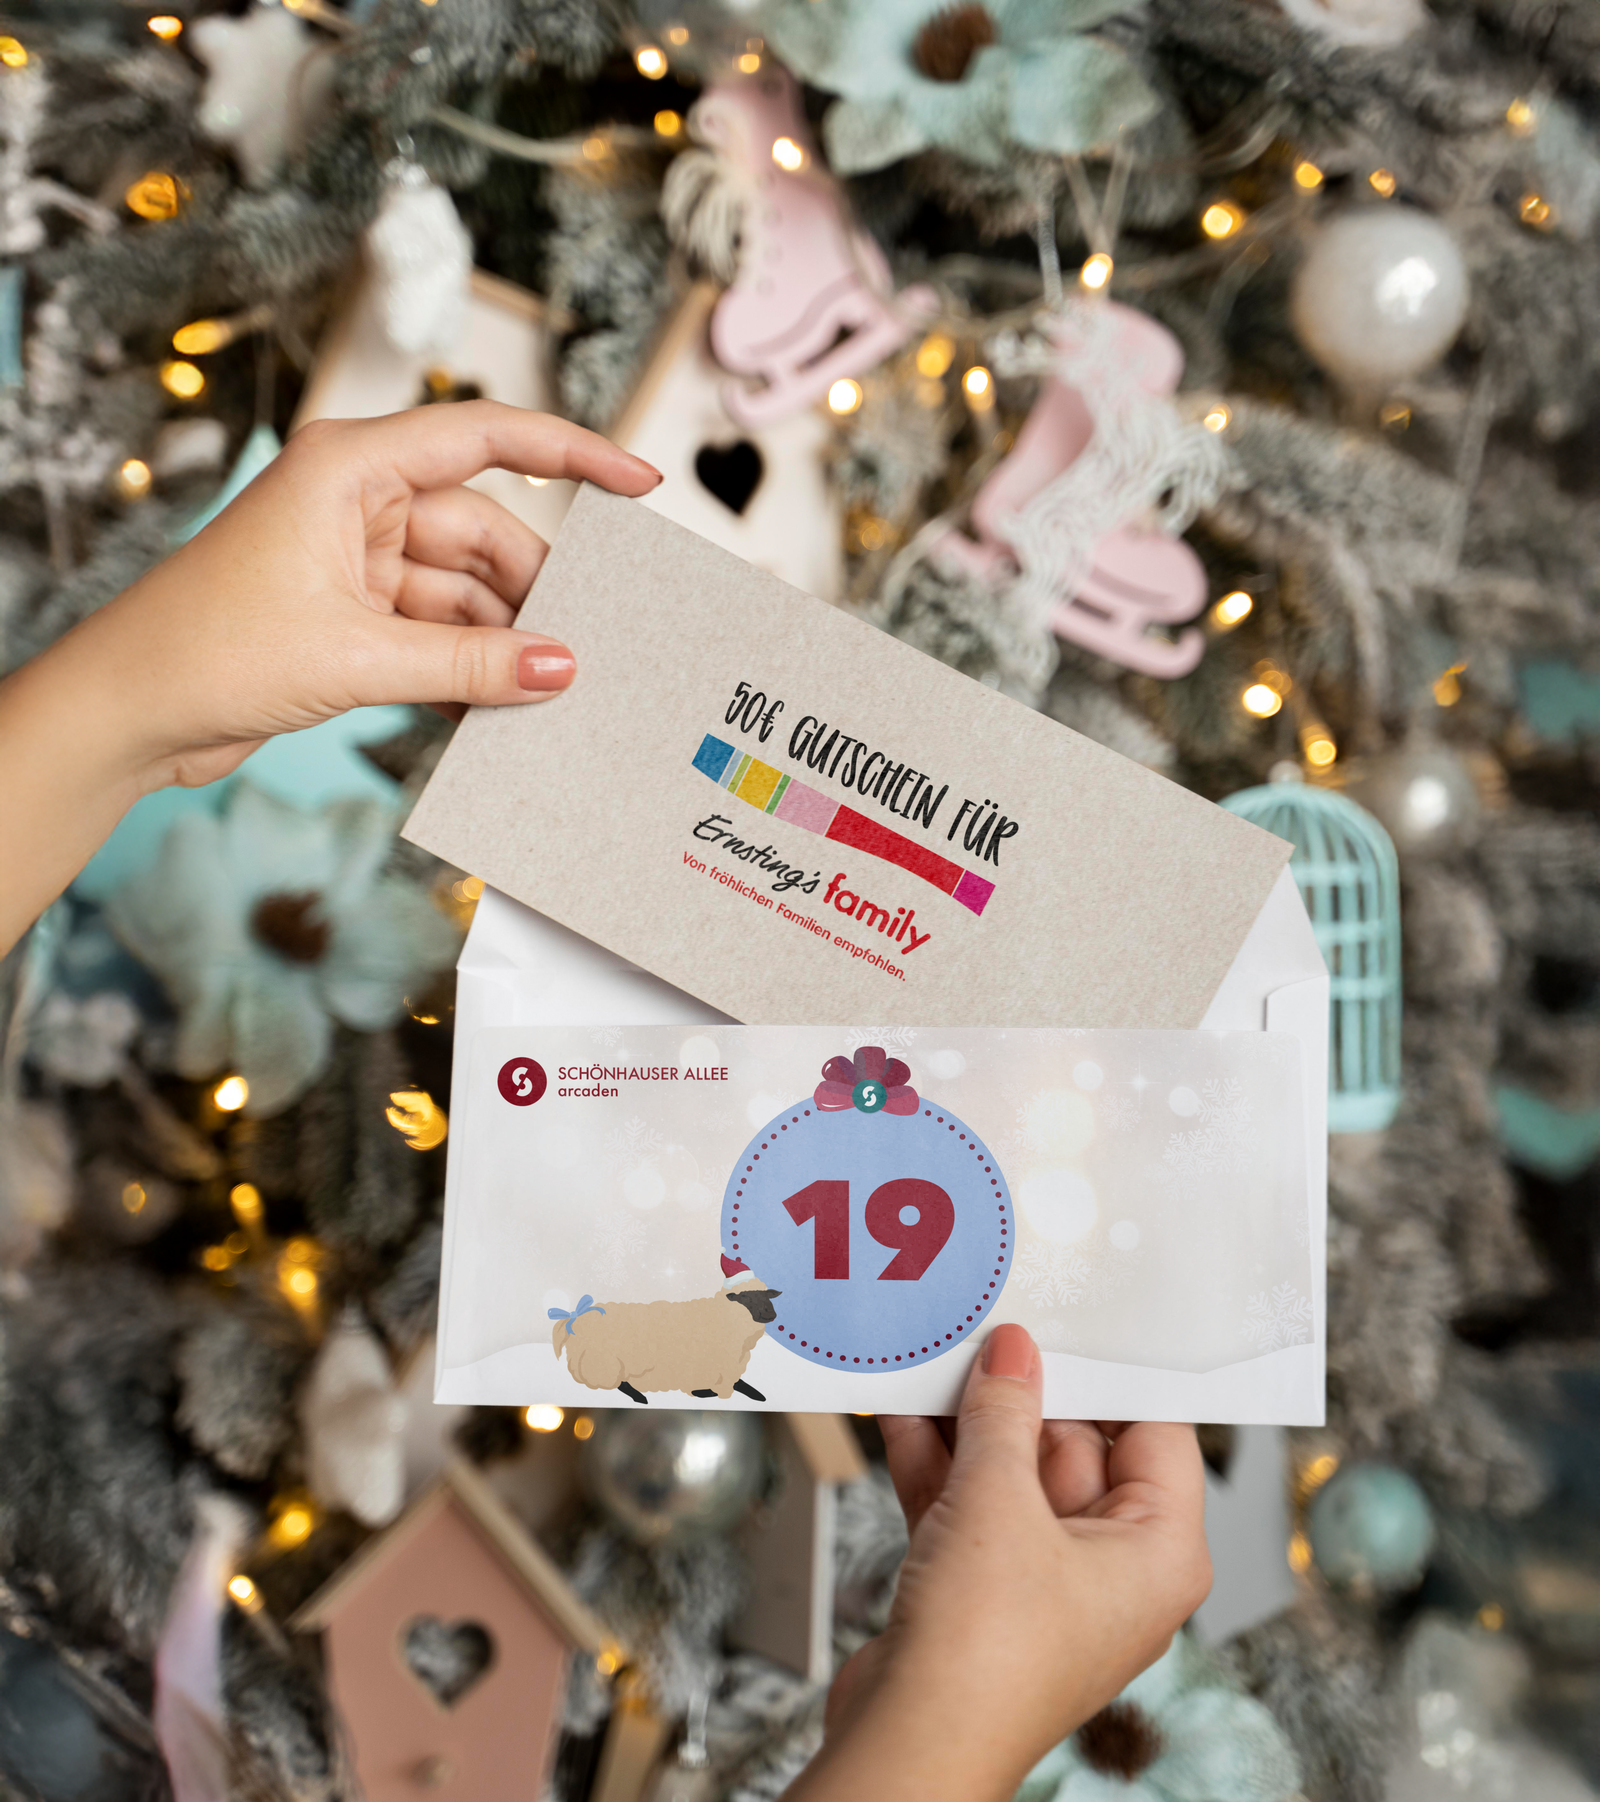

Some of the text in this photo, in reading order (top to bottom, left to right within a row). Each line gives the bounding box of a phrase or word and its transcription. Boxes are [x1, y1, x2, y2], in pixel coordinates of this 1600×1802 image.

[724, 681, 1020, 867] 50€ GUTSCHEIN FÜR
[683, 851, 907, 982] Von fröhlichen Familien empfohlen.
[822, 872, 931, 955] family
[557, 1063, 729, 1082] SCHÖNHAUSER ALLEE
[557, 1084, 619, 1099] arcaden
[781, 1177, 956, 1282] 19
